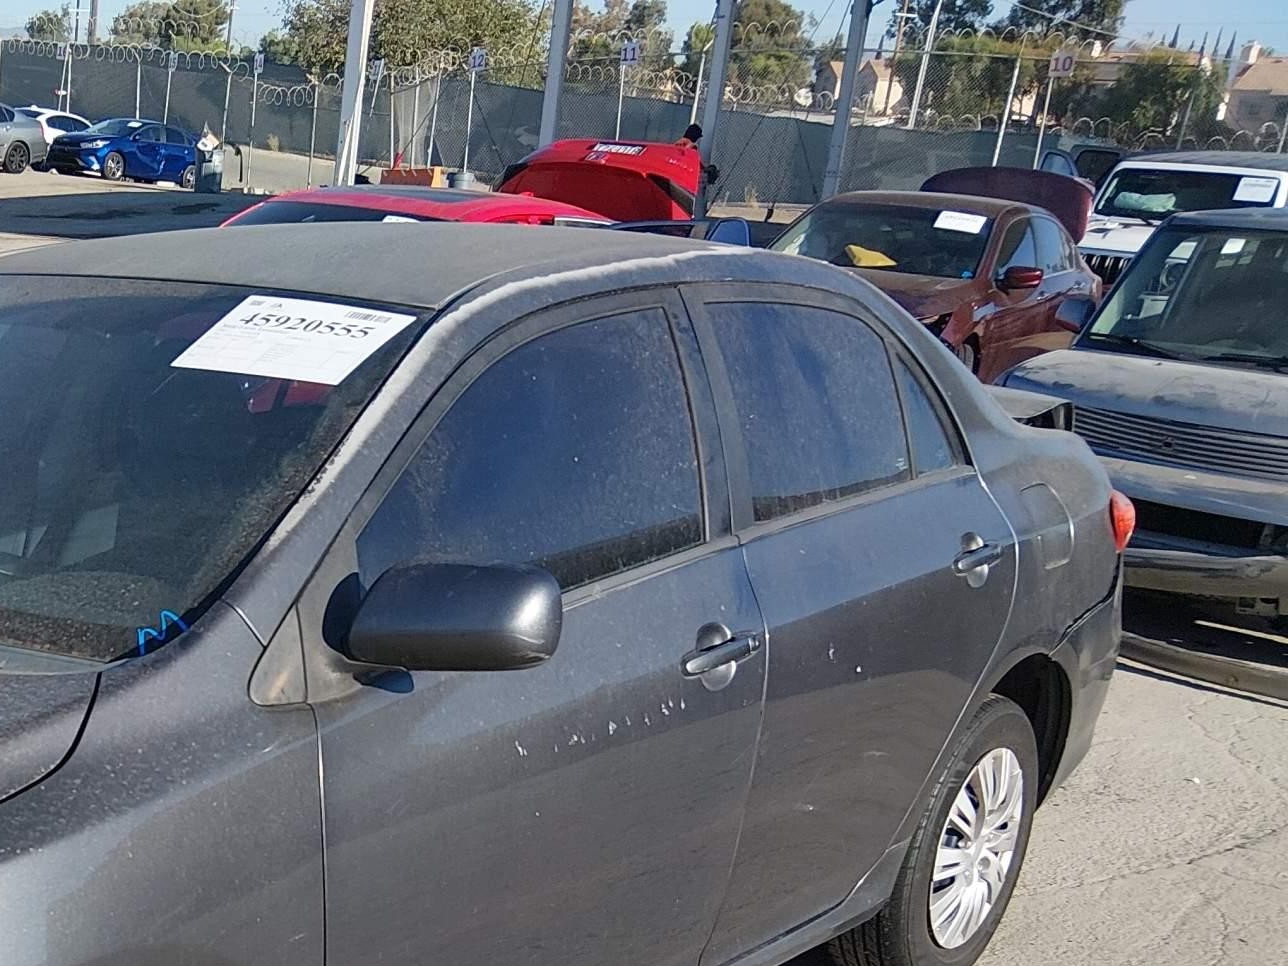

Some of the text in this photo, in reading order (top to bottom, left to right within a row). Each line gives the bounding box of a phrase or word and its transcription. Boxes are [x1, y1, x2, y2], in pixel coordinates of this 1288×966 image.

[471, 54, 485, 68] 12
[621, 47, 637, 61] 11
[1050, 56, 1073, 72] 10
[239, 312, 376, 339] 45920555
